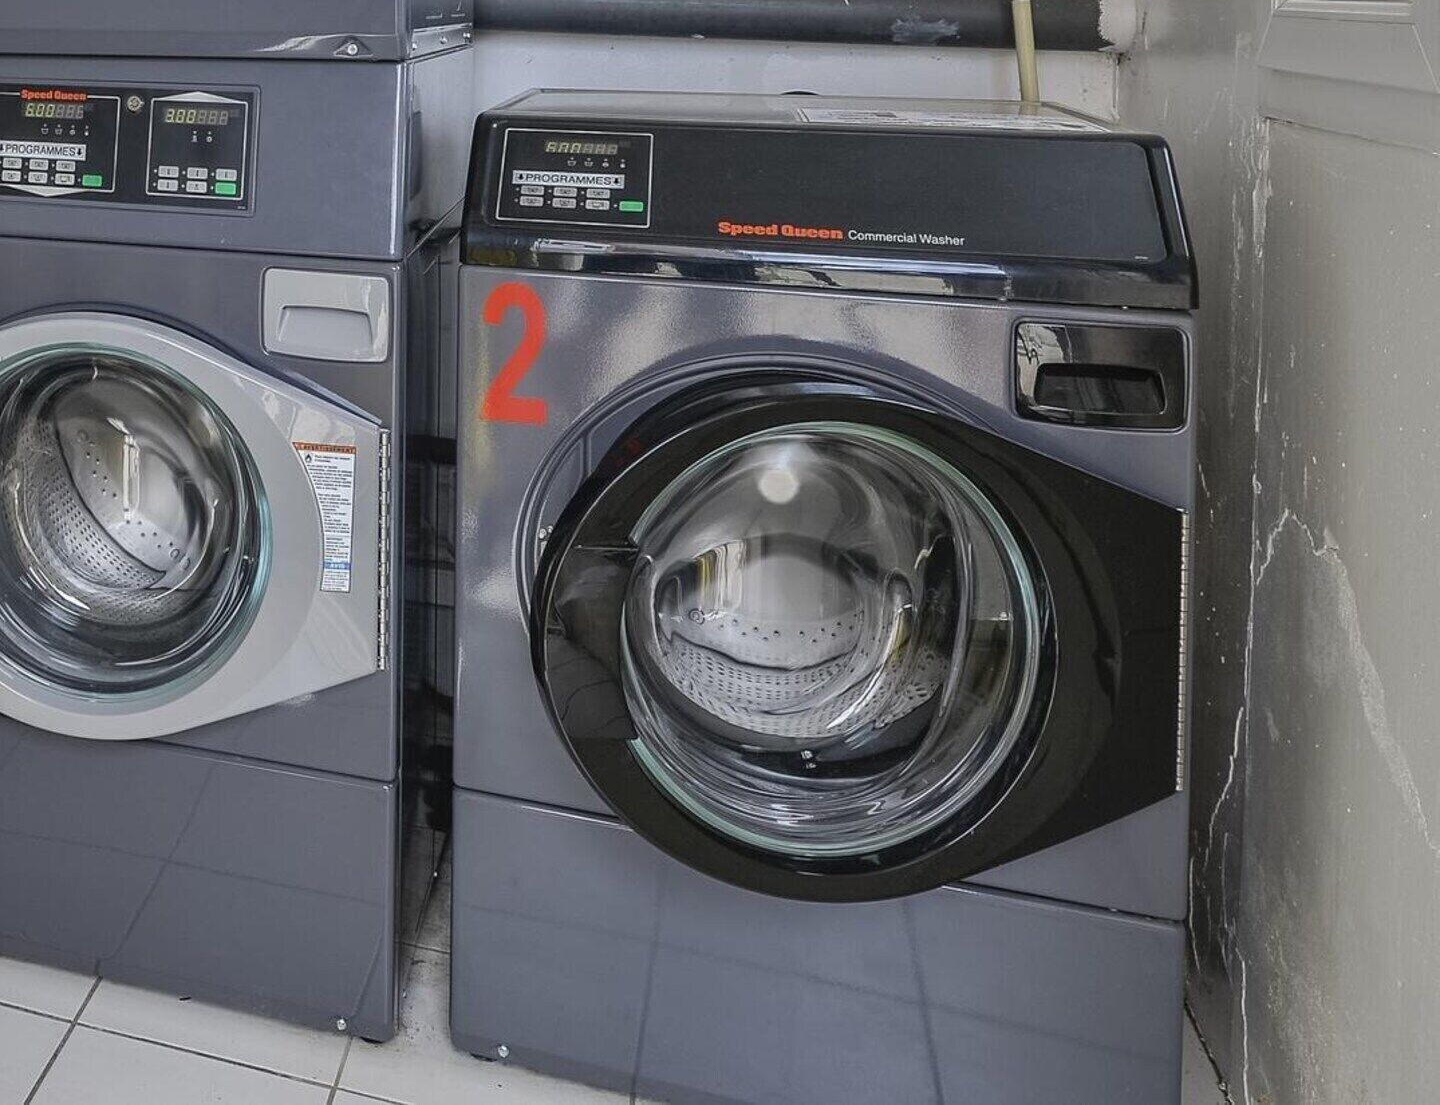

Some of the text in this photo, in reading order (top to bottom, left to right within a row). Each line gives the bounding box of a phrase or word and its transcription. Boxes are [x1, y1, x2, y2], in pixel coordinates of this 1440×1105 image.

[21, 89, 86, 100] Speed Queen
[6, 145, 75, 156] PROGRAMMES
[526, 173, 612, 185] PROGRAMMES
[718, 221, 965, 245] Speed Queen Commercial Washer
[481, 282, 548, 425] 2
